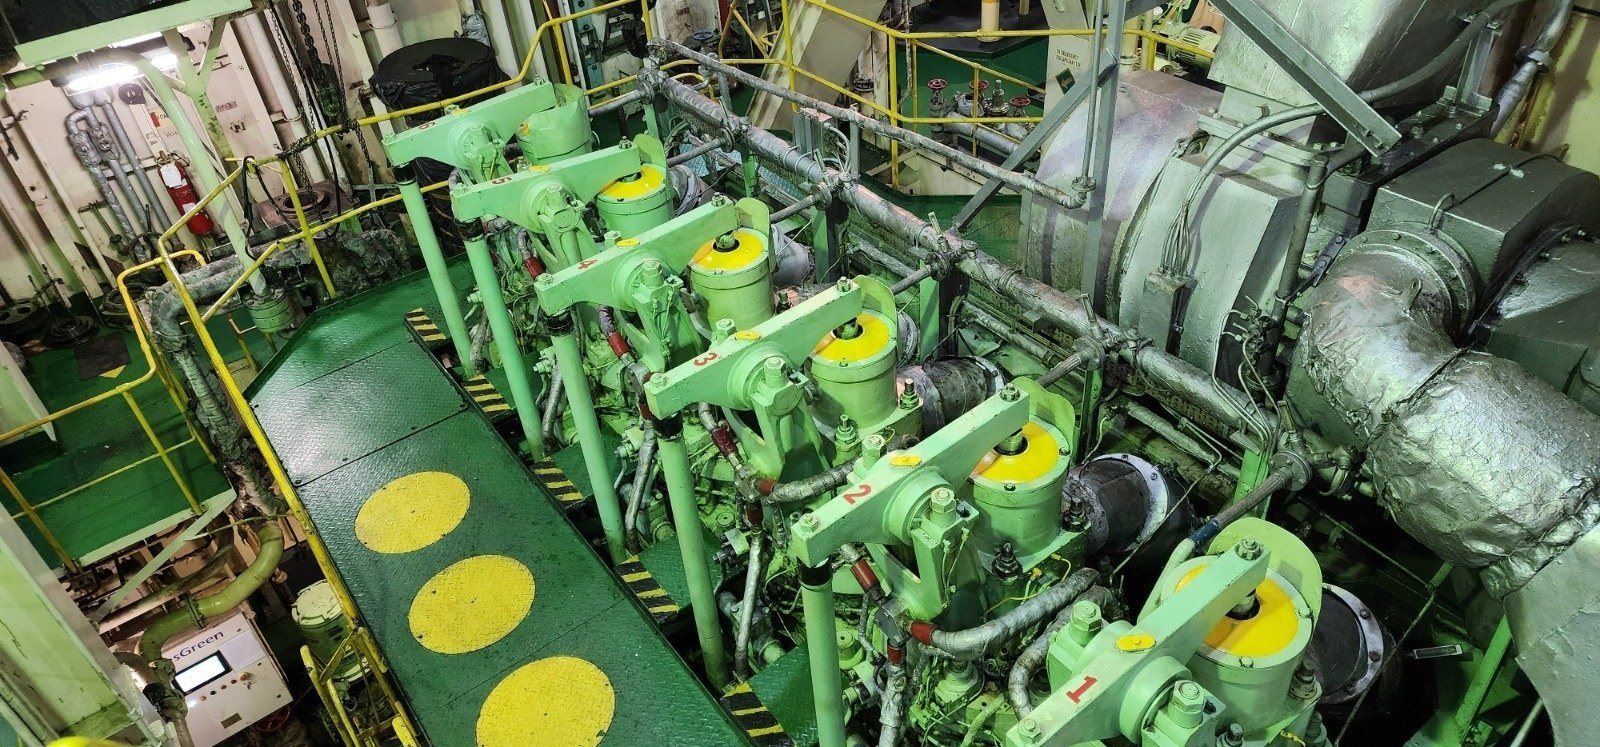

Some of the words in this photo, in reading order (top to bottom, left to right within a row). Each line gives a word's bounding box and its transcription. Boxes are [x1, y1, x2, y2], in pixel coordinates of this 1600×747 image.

[491, 176, 513, 185] 5
[578, 259, 598, 270] 4
[693, 352, 718, 367] 3
[842, 484, 872, 506] 2
[170, 631, 224, 661] sGreen
[1065, 675, 1098, 705] 1
